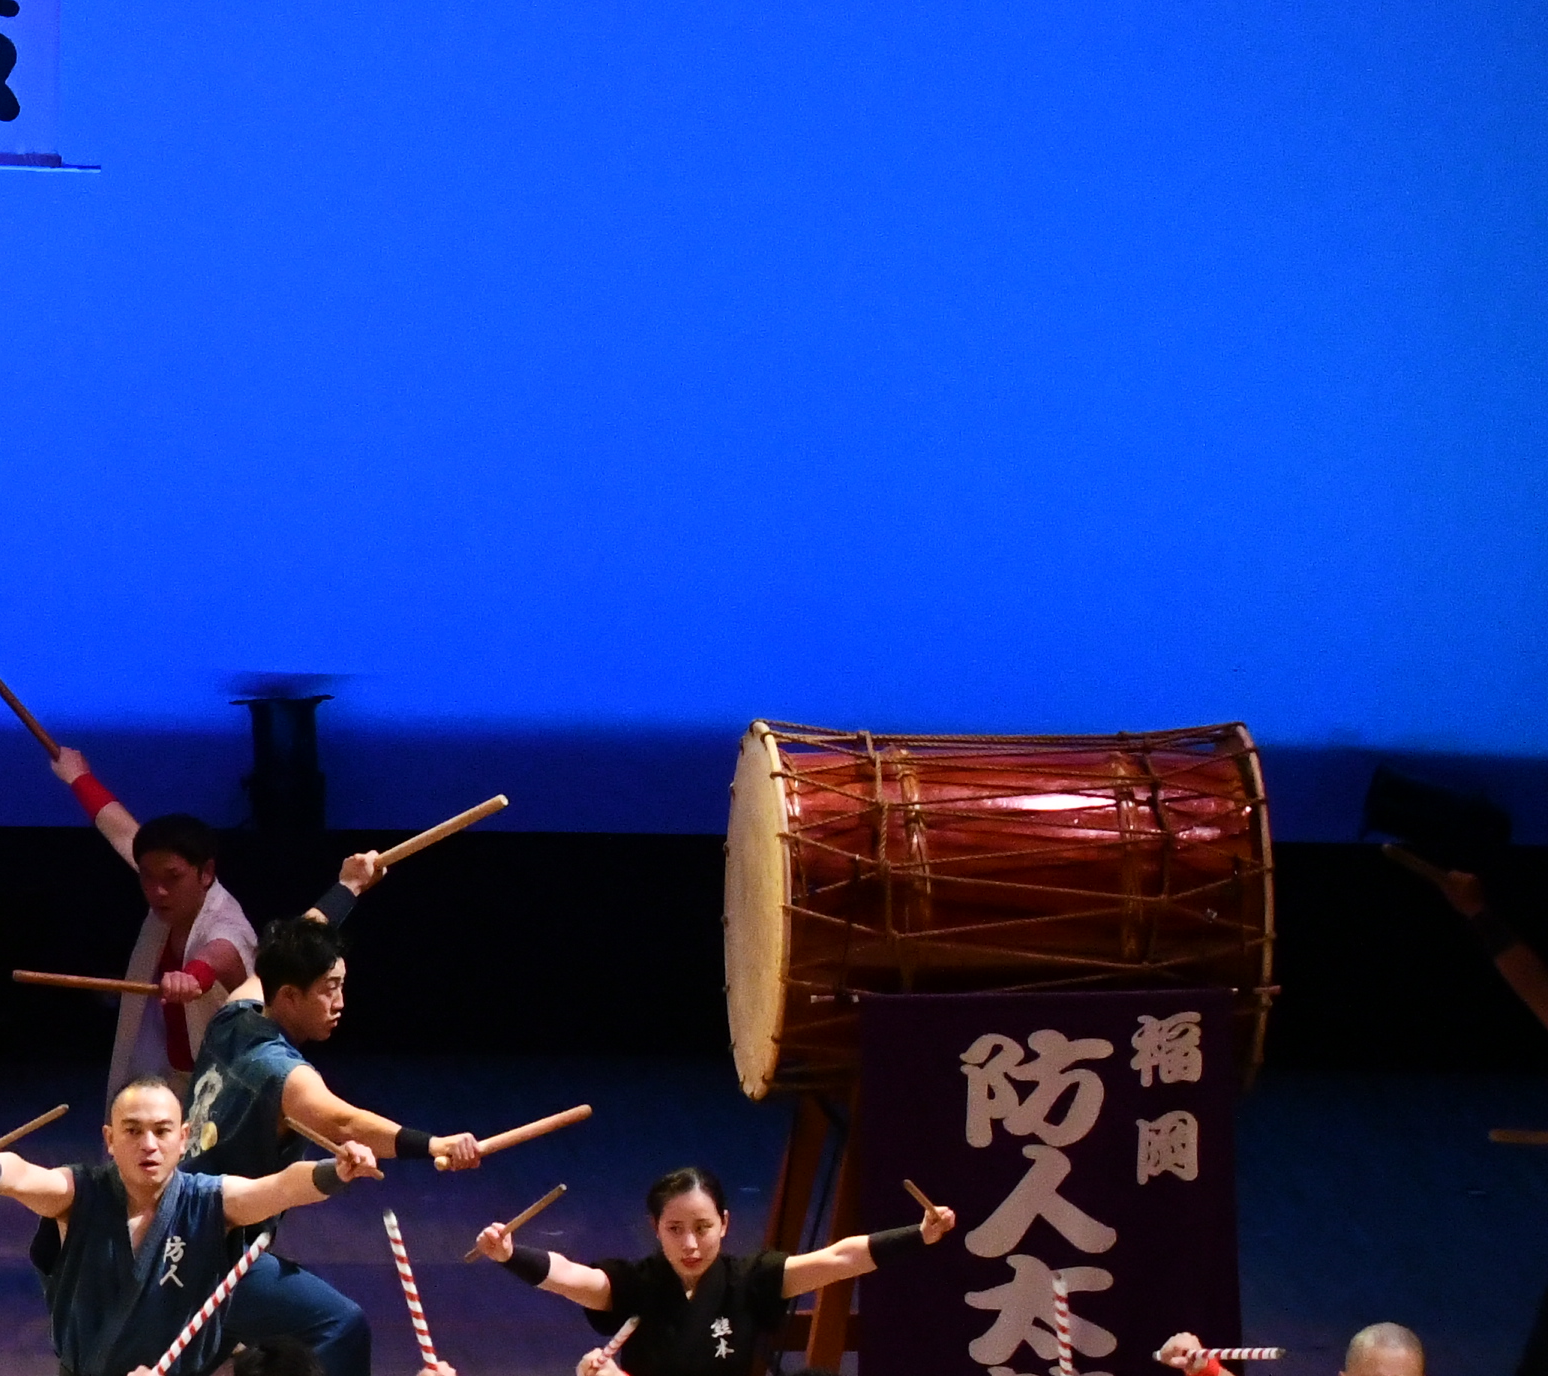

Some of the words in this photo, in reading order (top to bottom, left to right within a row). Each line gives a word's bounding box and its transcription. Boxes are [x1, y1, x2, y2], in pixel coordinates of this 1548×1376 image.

[1128, 1010, 1203, 1185] 福岡
[159, 1235, 186, 1288] 防人
[710, 1316, 735, 1360] 熊本
